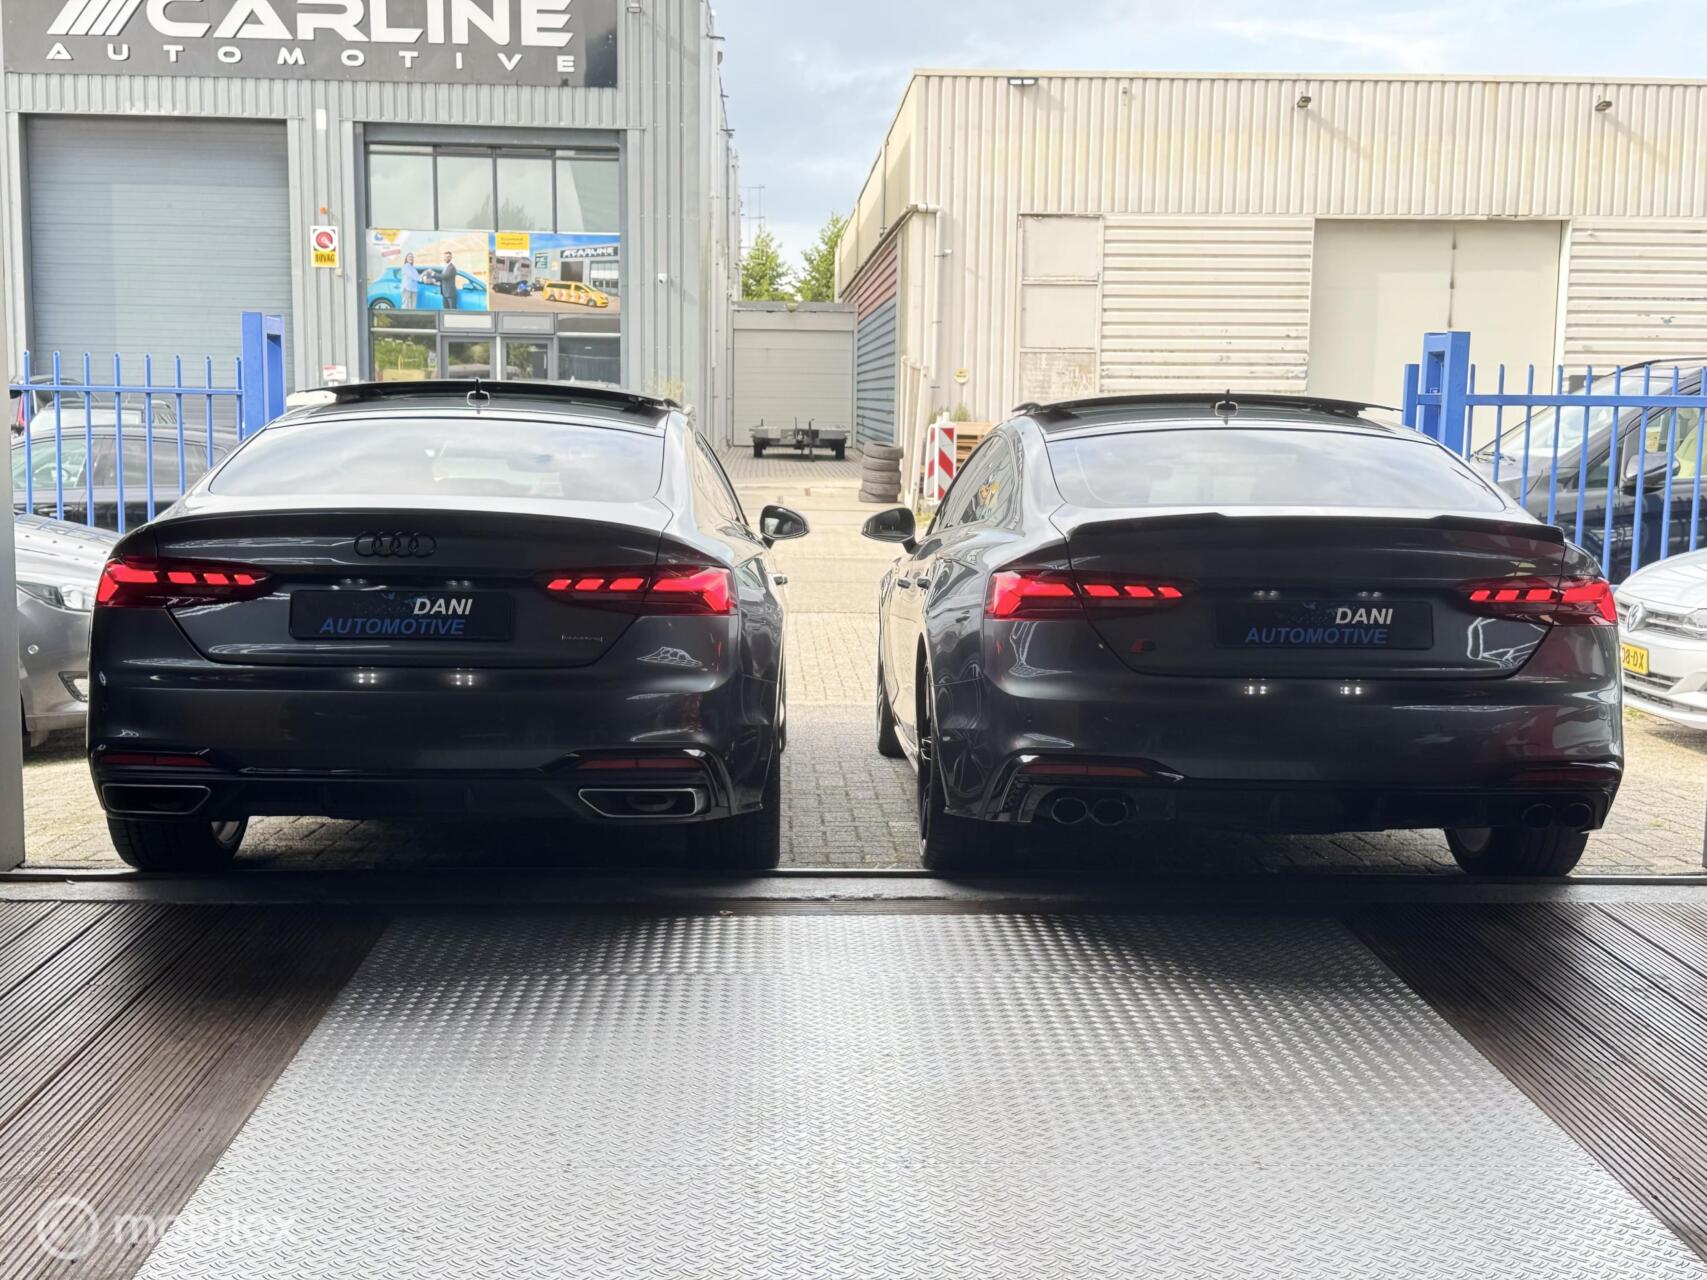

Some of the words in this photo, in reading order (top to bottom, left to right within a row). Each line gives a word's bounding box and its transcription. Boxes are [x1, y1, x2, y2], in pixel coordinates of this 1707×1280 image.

[46, 41, 576, 73] AUTOMOTIVE
[413, 598, 473, 616] DANI
[1335, 608, 1394, 625] DANI
[320, 618, 465, 635] AUTOMOTIVE
[1245, 628, 1388, 645] AUTOMOTIVE
